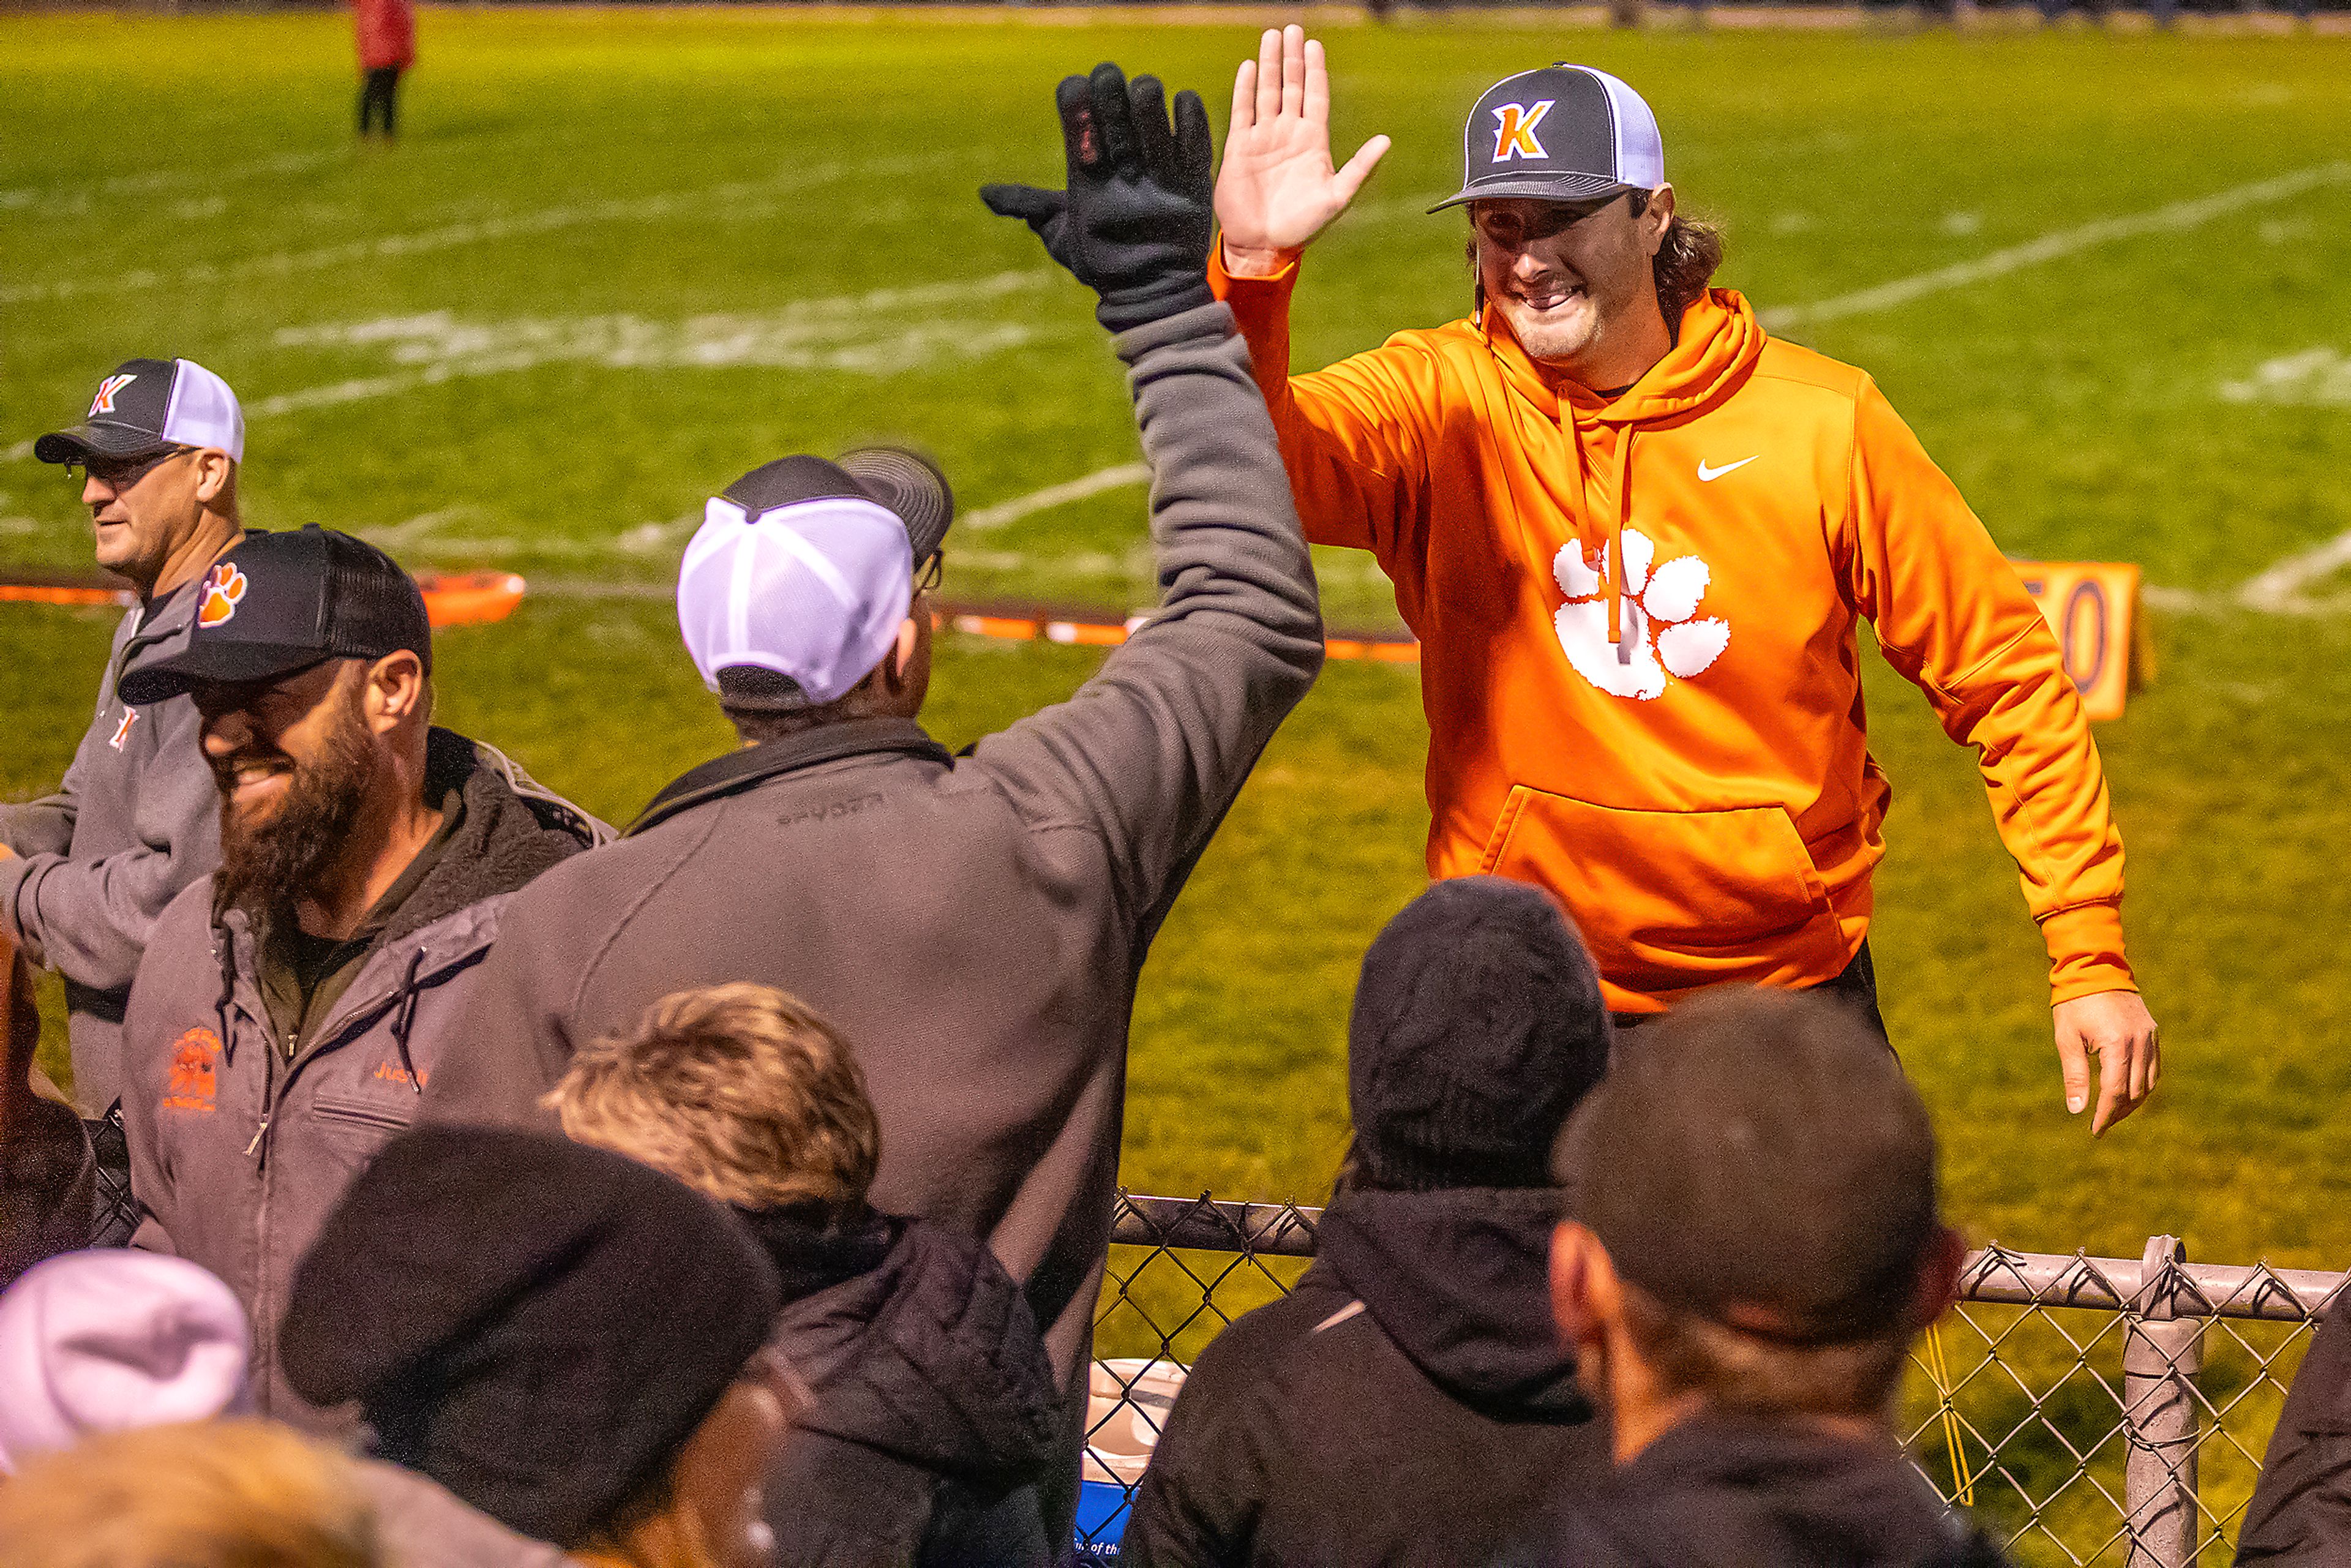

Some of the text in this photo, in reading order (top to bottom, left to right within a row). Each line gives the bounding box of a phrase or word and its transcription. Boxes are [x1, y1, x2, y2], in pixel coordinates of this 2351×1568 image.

[1491, 99, 1556, 163] K
[88, 374, 138, 418] K
[2022, 581, 2105, 695] 0
[1090, 1542, 1104, 1556] of
